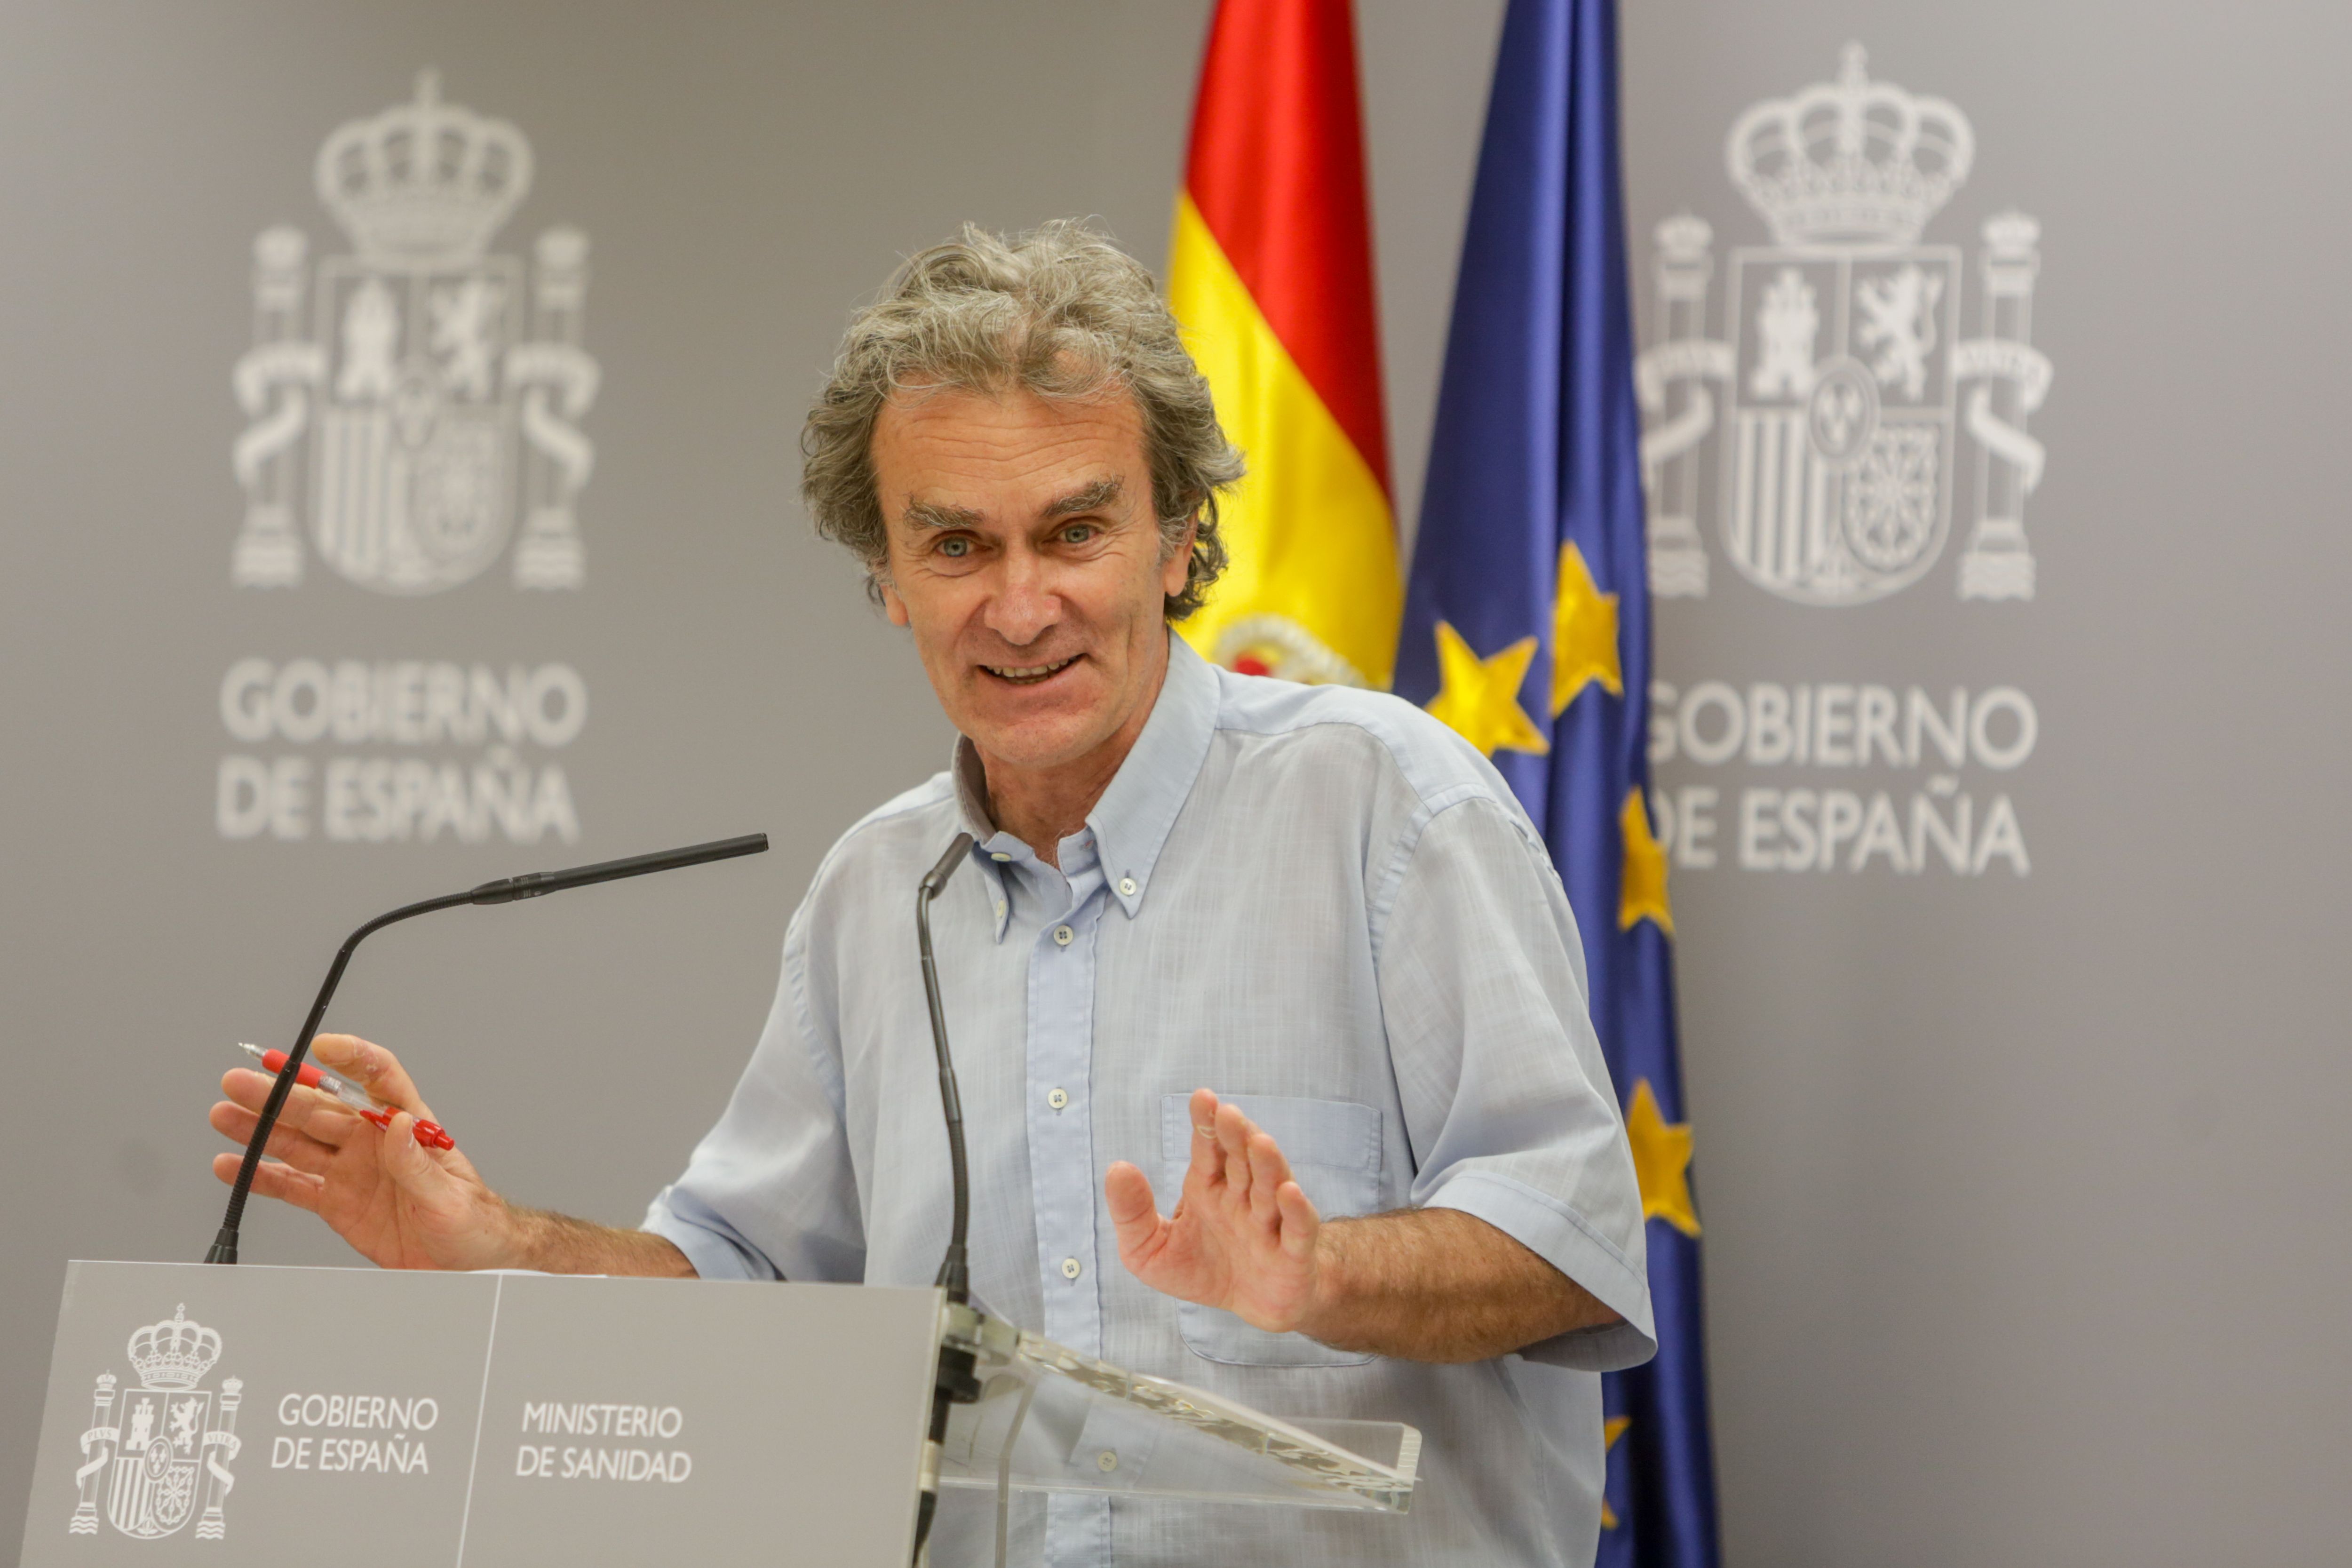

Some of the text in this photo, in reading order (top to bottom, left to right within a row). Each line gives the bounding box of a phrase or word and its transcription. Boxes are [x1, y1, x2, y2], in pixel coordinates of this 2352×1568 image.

[220, 659, 587, 747] GOBIERNO
[217, 746, 580, 843] DE ESPAÑA
[1740, 774, 2031, 877] ESPAÑA
[278, 1393, 439, 1431] GOBIERNO
[522, 1401, 683, 1439] MINISTERIO
[270, 1433, 429, 1474] DE ESPAÑA
[516, 1445, 692, 1483] DE SANIDAD
